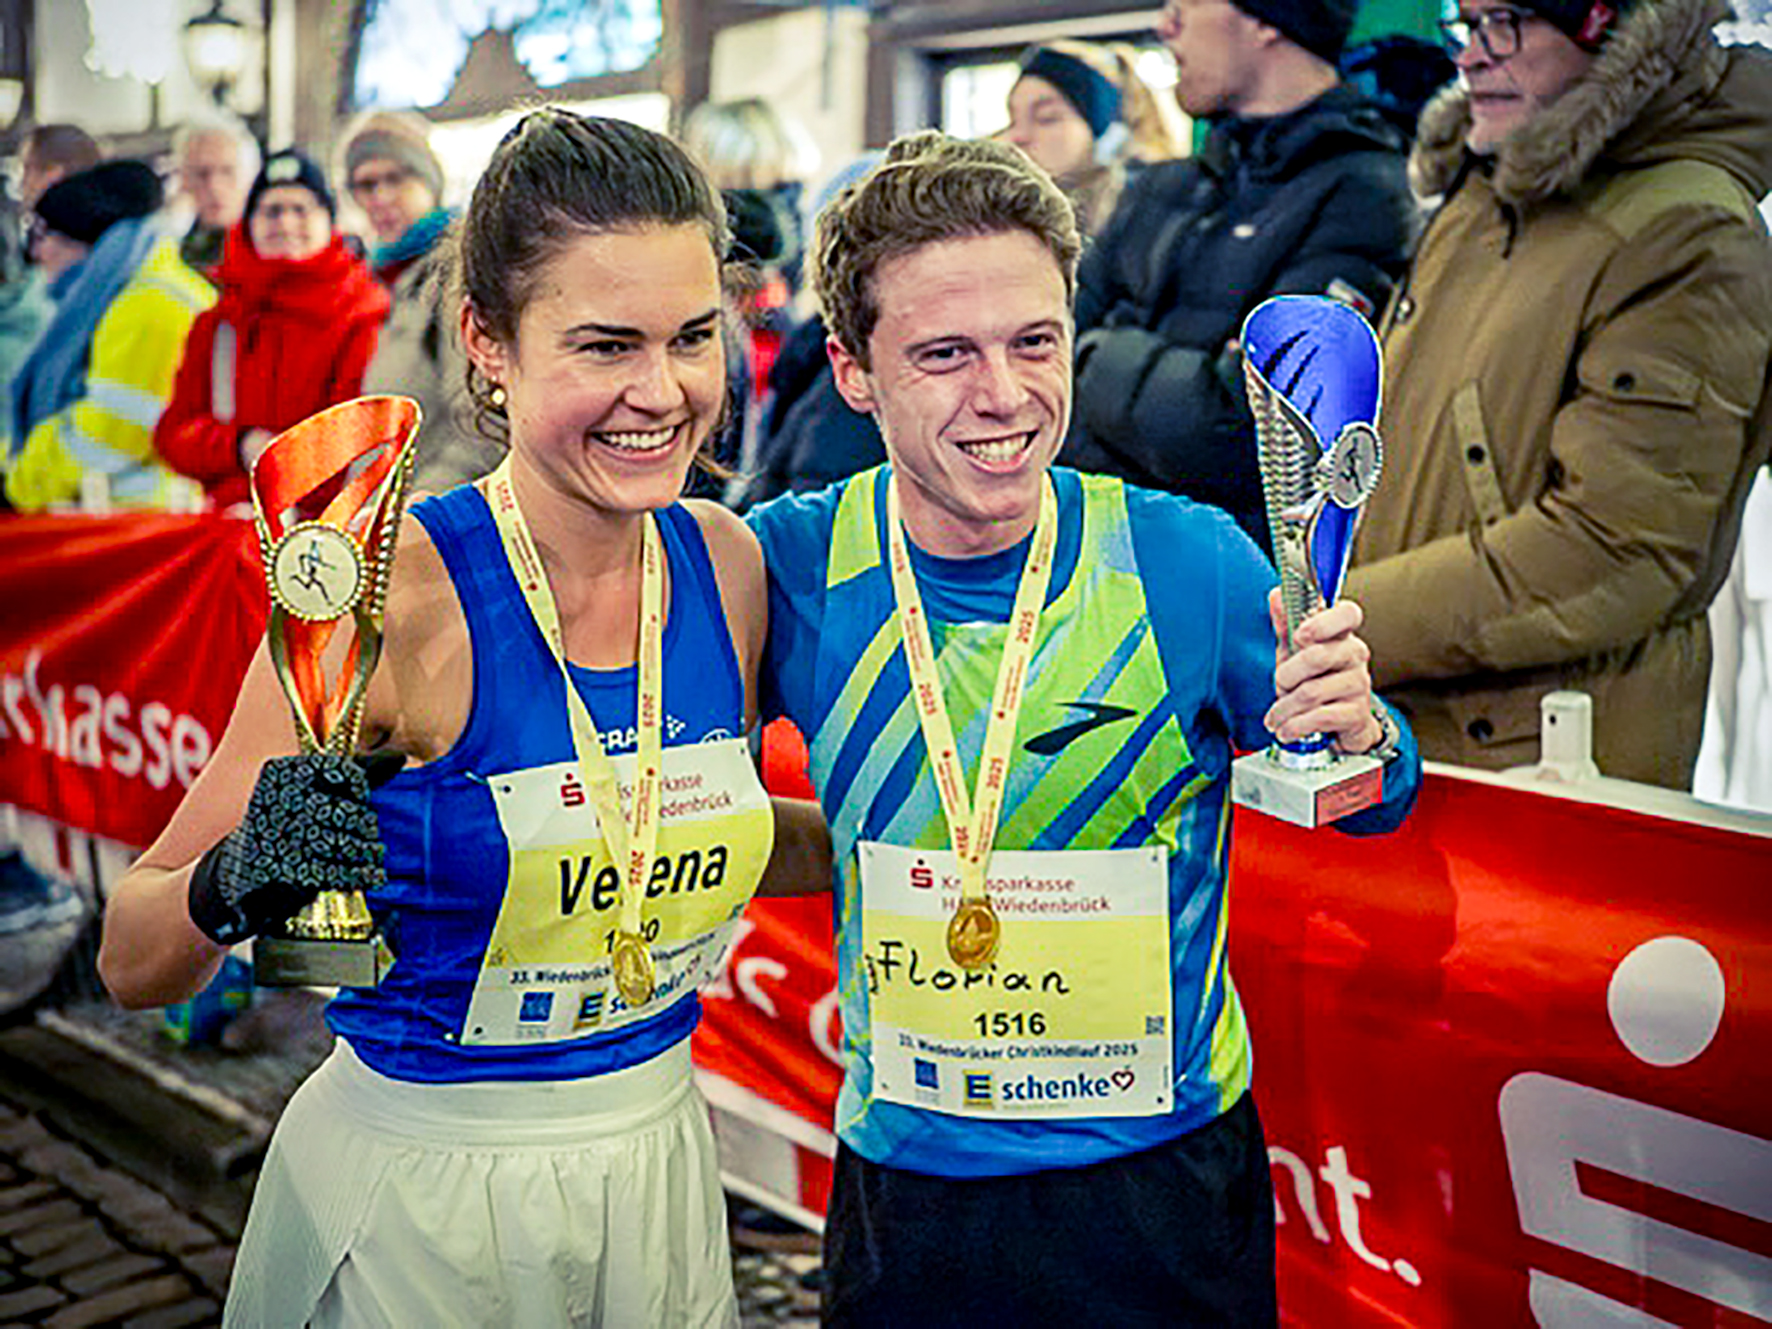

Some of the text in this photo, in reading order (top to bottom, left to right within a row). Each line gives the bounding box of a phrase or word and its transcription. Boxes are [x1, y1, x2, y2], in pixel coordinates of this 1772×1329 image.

[0, 649, 211, 790] rkasse
[559, 845, 728, 916] Veena
[604, 917, 660, 954] 10
[974, 1012, 1047, 1037] 1516
[1104, 1043, 1139, 1057] 2025
[1002, 1072, 1110, 1100] schenke
[1267, 1145, 1421, 1286] nt.
